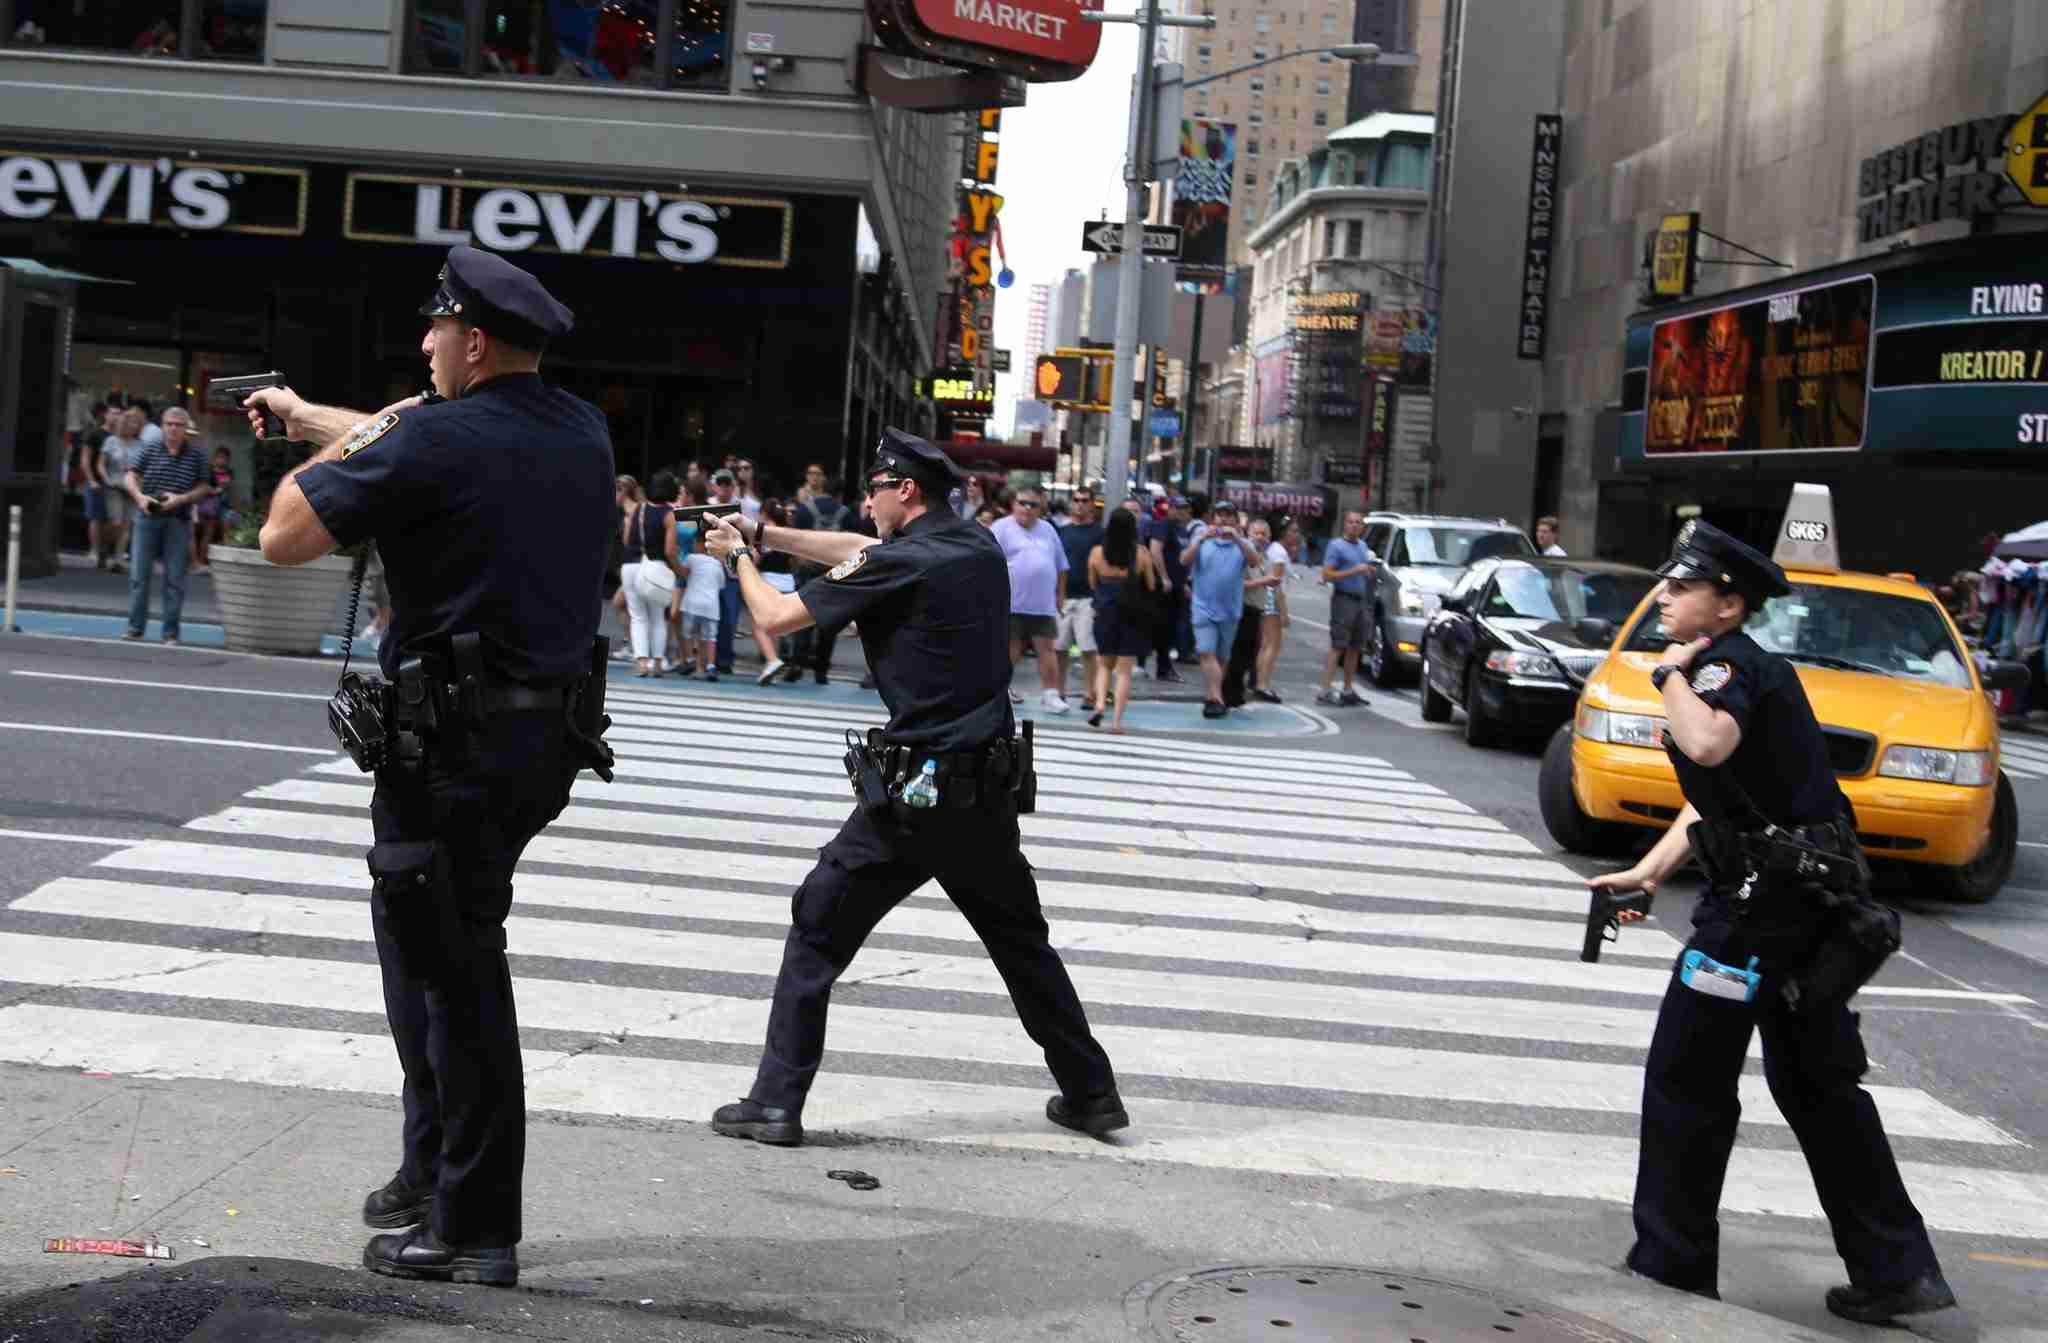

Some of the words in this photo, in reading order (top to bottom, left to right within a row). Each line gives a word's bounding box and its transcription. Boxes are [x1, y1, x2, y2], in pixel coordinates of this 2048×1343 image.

[953, 0, 1068, 41] MARKET
[1531, 121, 1559, 241] MINSKOFF
[1860, 137, 1922, 198] BEST
[1856, 173, 2000, 243] THEATER
[1102, 230, 1123, 245] ON
[1522, 248, 1547, 354] THEATRE
[1970, 283, 2044, 315] FLYING
[1940, 350, 2027, 381] KREATOR
